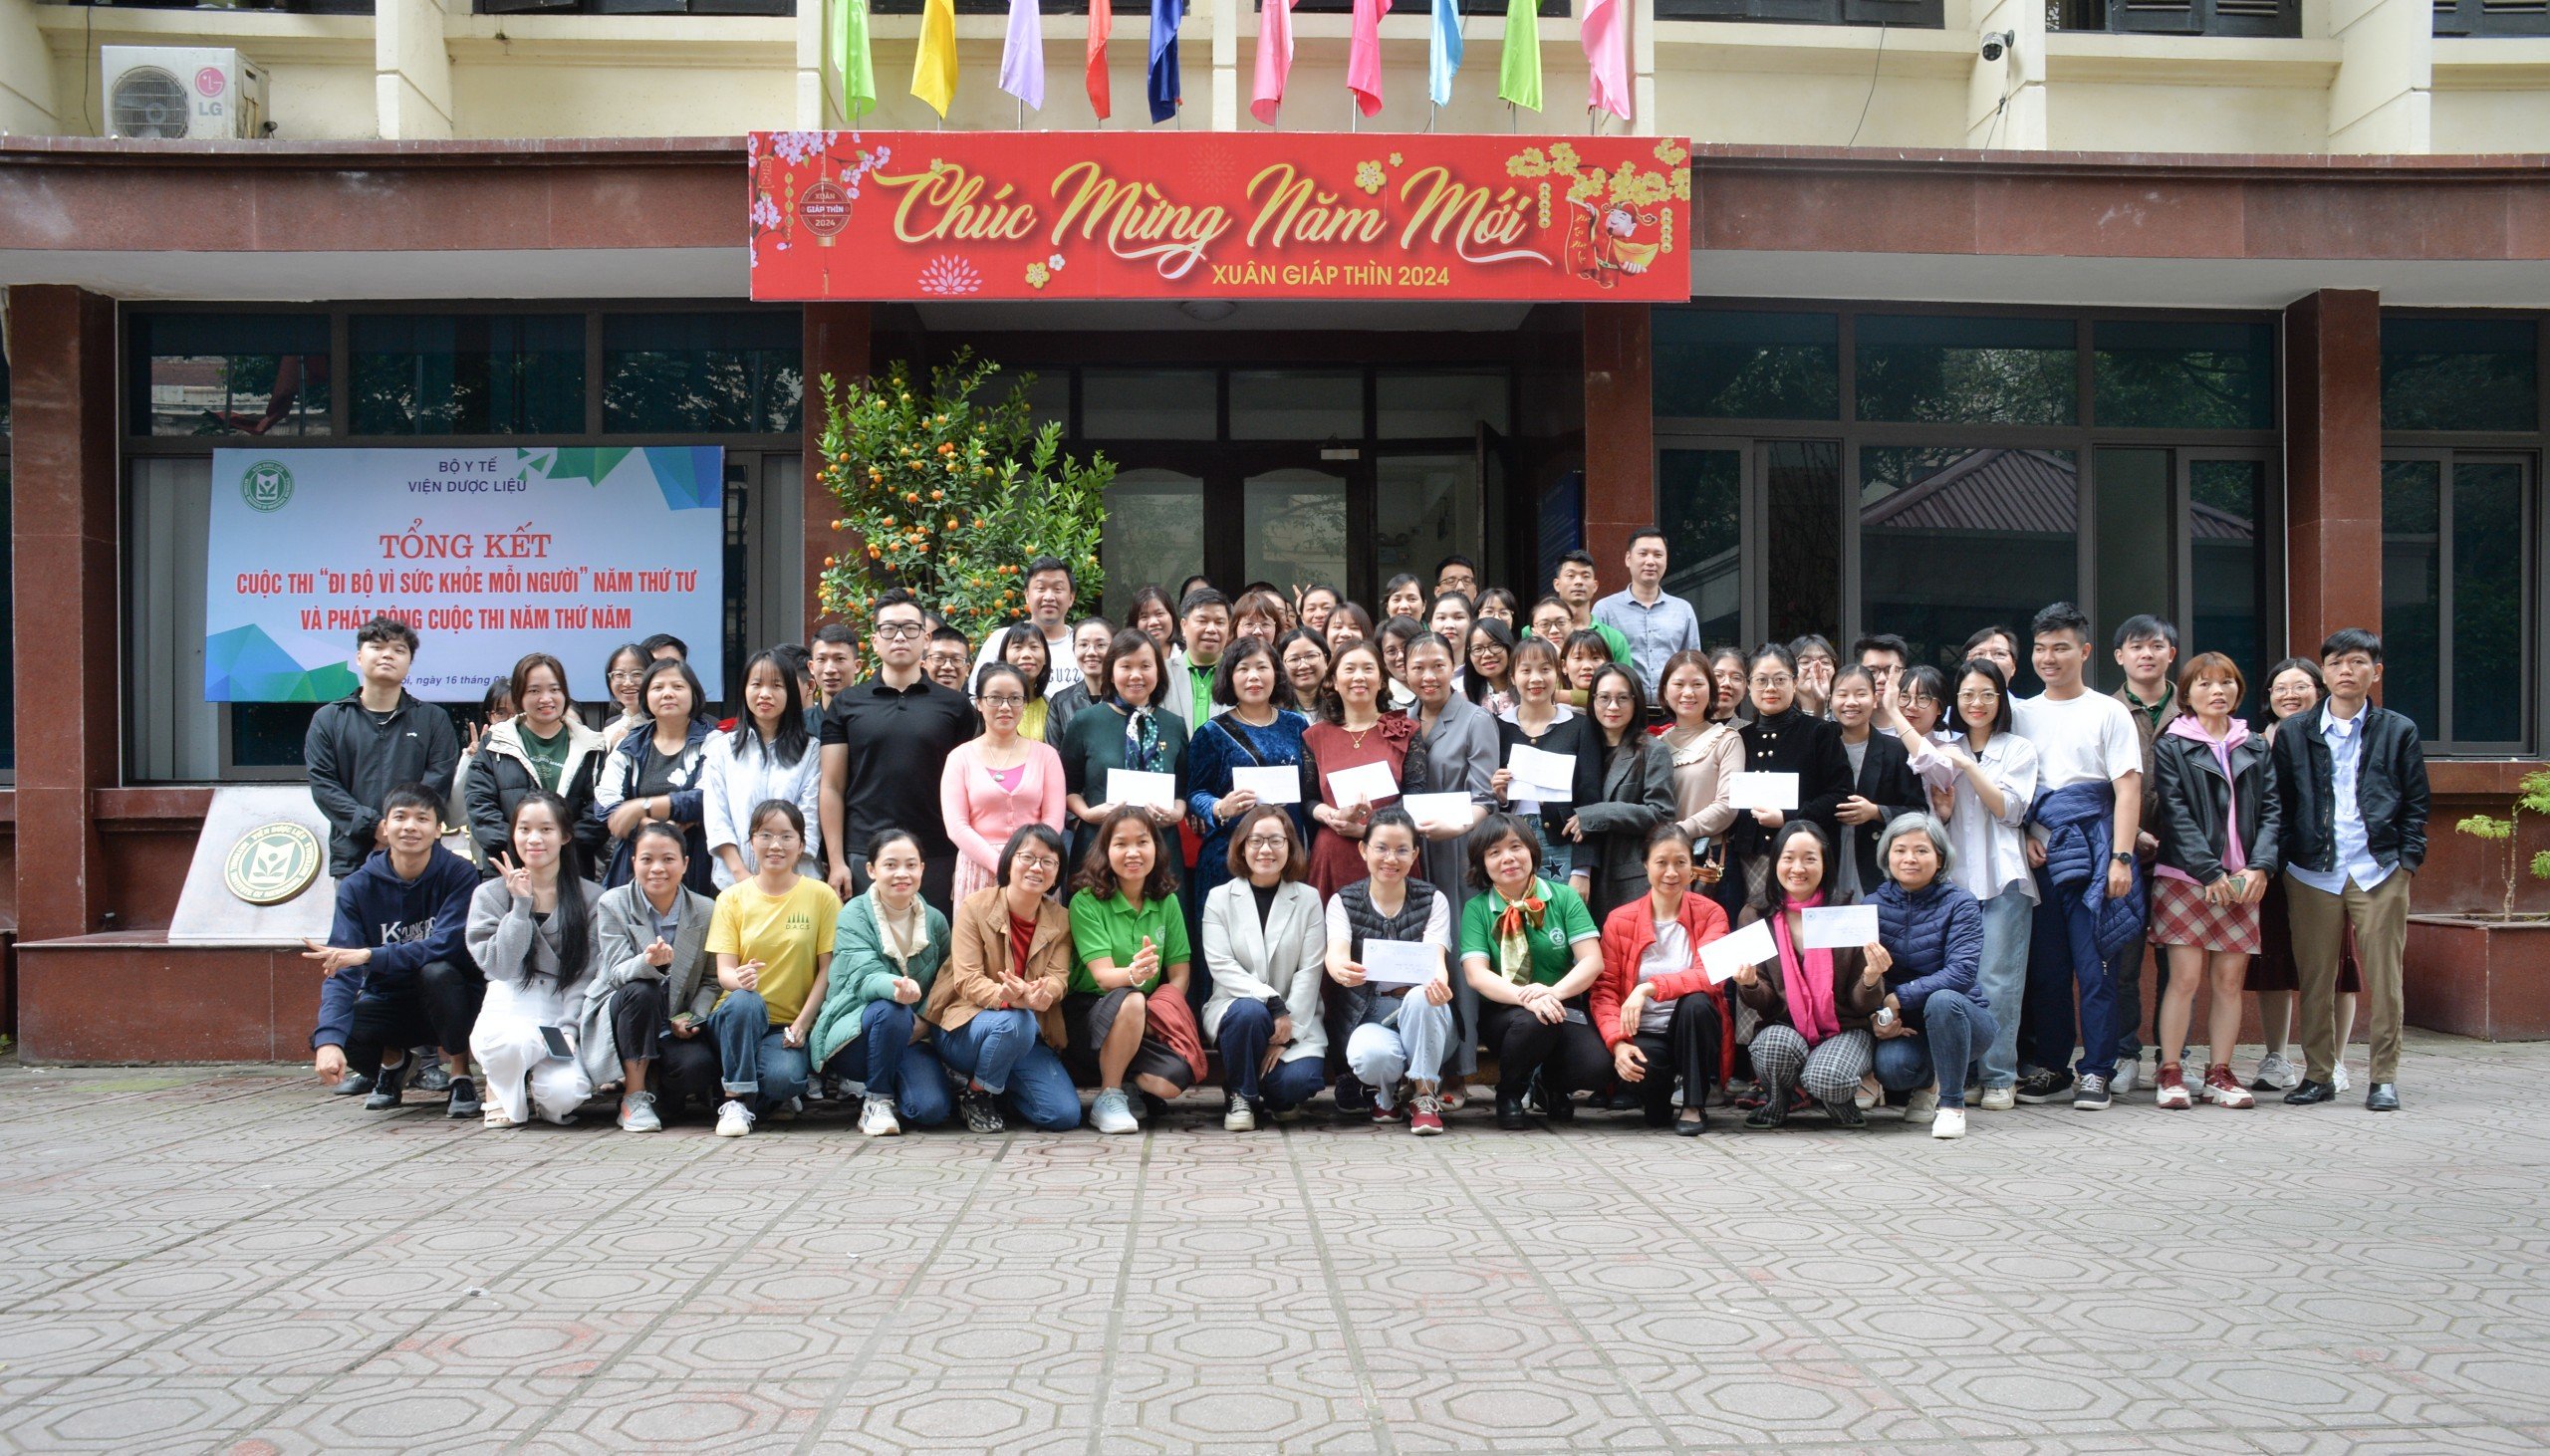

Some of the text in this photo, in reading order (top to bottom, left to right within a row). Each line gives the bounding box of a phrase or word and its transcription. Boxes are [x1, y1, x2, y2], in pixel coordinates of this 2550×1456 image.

[198, 102, 223, 117] LG
[807, 204, 844, 213] GIÁP THÌN
[871, 162, 1038, 244] Chúc
[1051, 160, 1233, 280] Mừng
[1246, 162, 1388, 249] Năm
[1399, 165, 1554, 266] Mới
[1212, 259, 1449, 286] XUÂN GIÁP THÌN 2024
[438, 456, 498, 474] BỘ Y TẾ
[408, 478, 527, 494] VIỆN DƯỢC LIỆU
[380, 518, 551, 559] TỔNG KẾT
[237, 569, 282, 599] CUỘC
[288, 573, 314, 594] THI
[351, 569, 374, 598] BỘ
[379, 569, 394, 594] VÌ
[399, 568, 433, 594] SỨC
[439, 566, 483, 594] KHỎE
[489, 565, 521, 594] MỖI
[594, 567, 634, 593] NĂM
[638, 567, 672, 593] THỨ
[674, 569, 697, 593] TƯ
[301, 606, 323, 630] VÀ
[328, 606, 372, 630] PHÁT
[428, 605, 473, 634] CUỘC
[478, 608, 504, 629] THI
[510, 604, 549, 629] NĂM
[555, 604, 588, 629] THỨ
[592, 604, 632, 629] NĂM
[415, 675, 442, 687] ngày
[445, 675, 458, 685] 16
[459, 675, 490, 687] tháng
